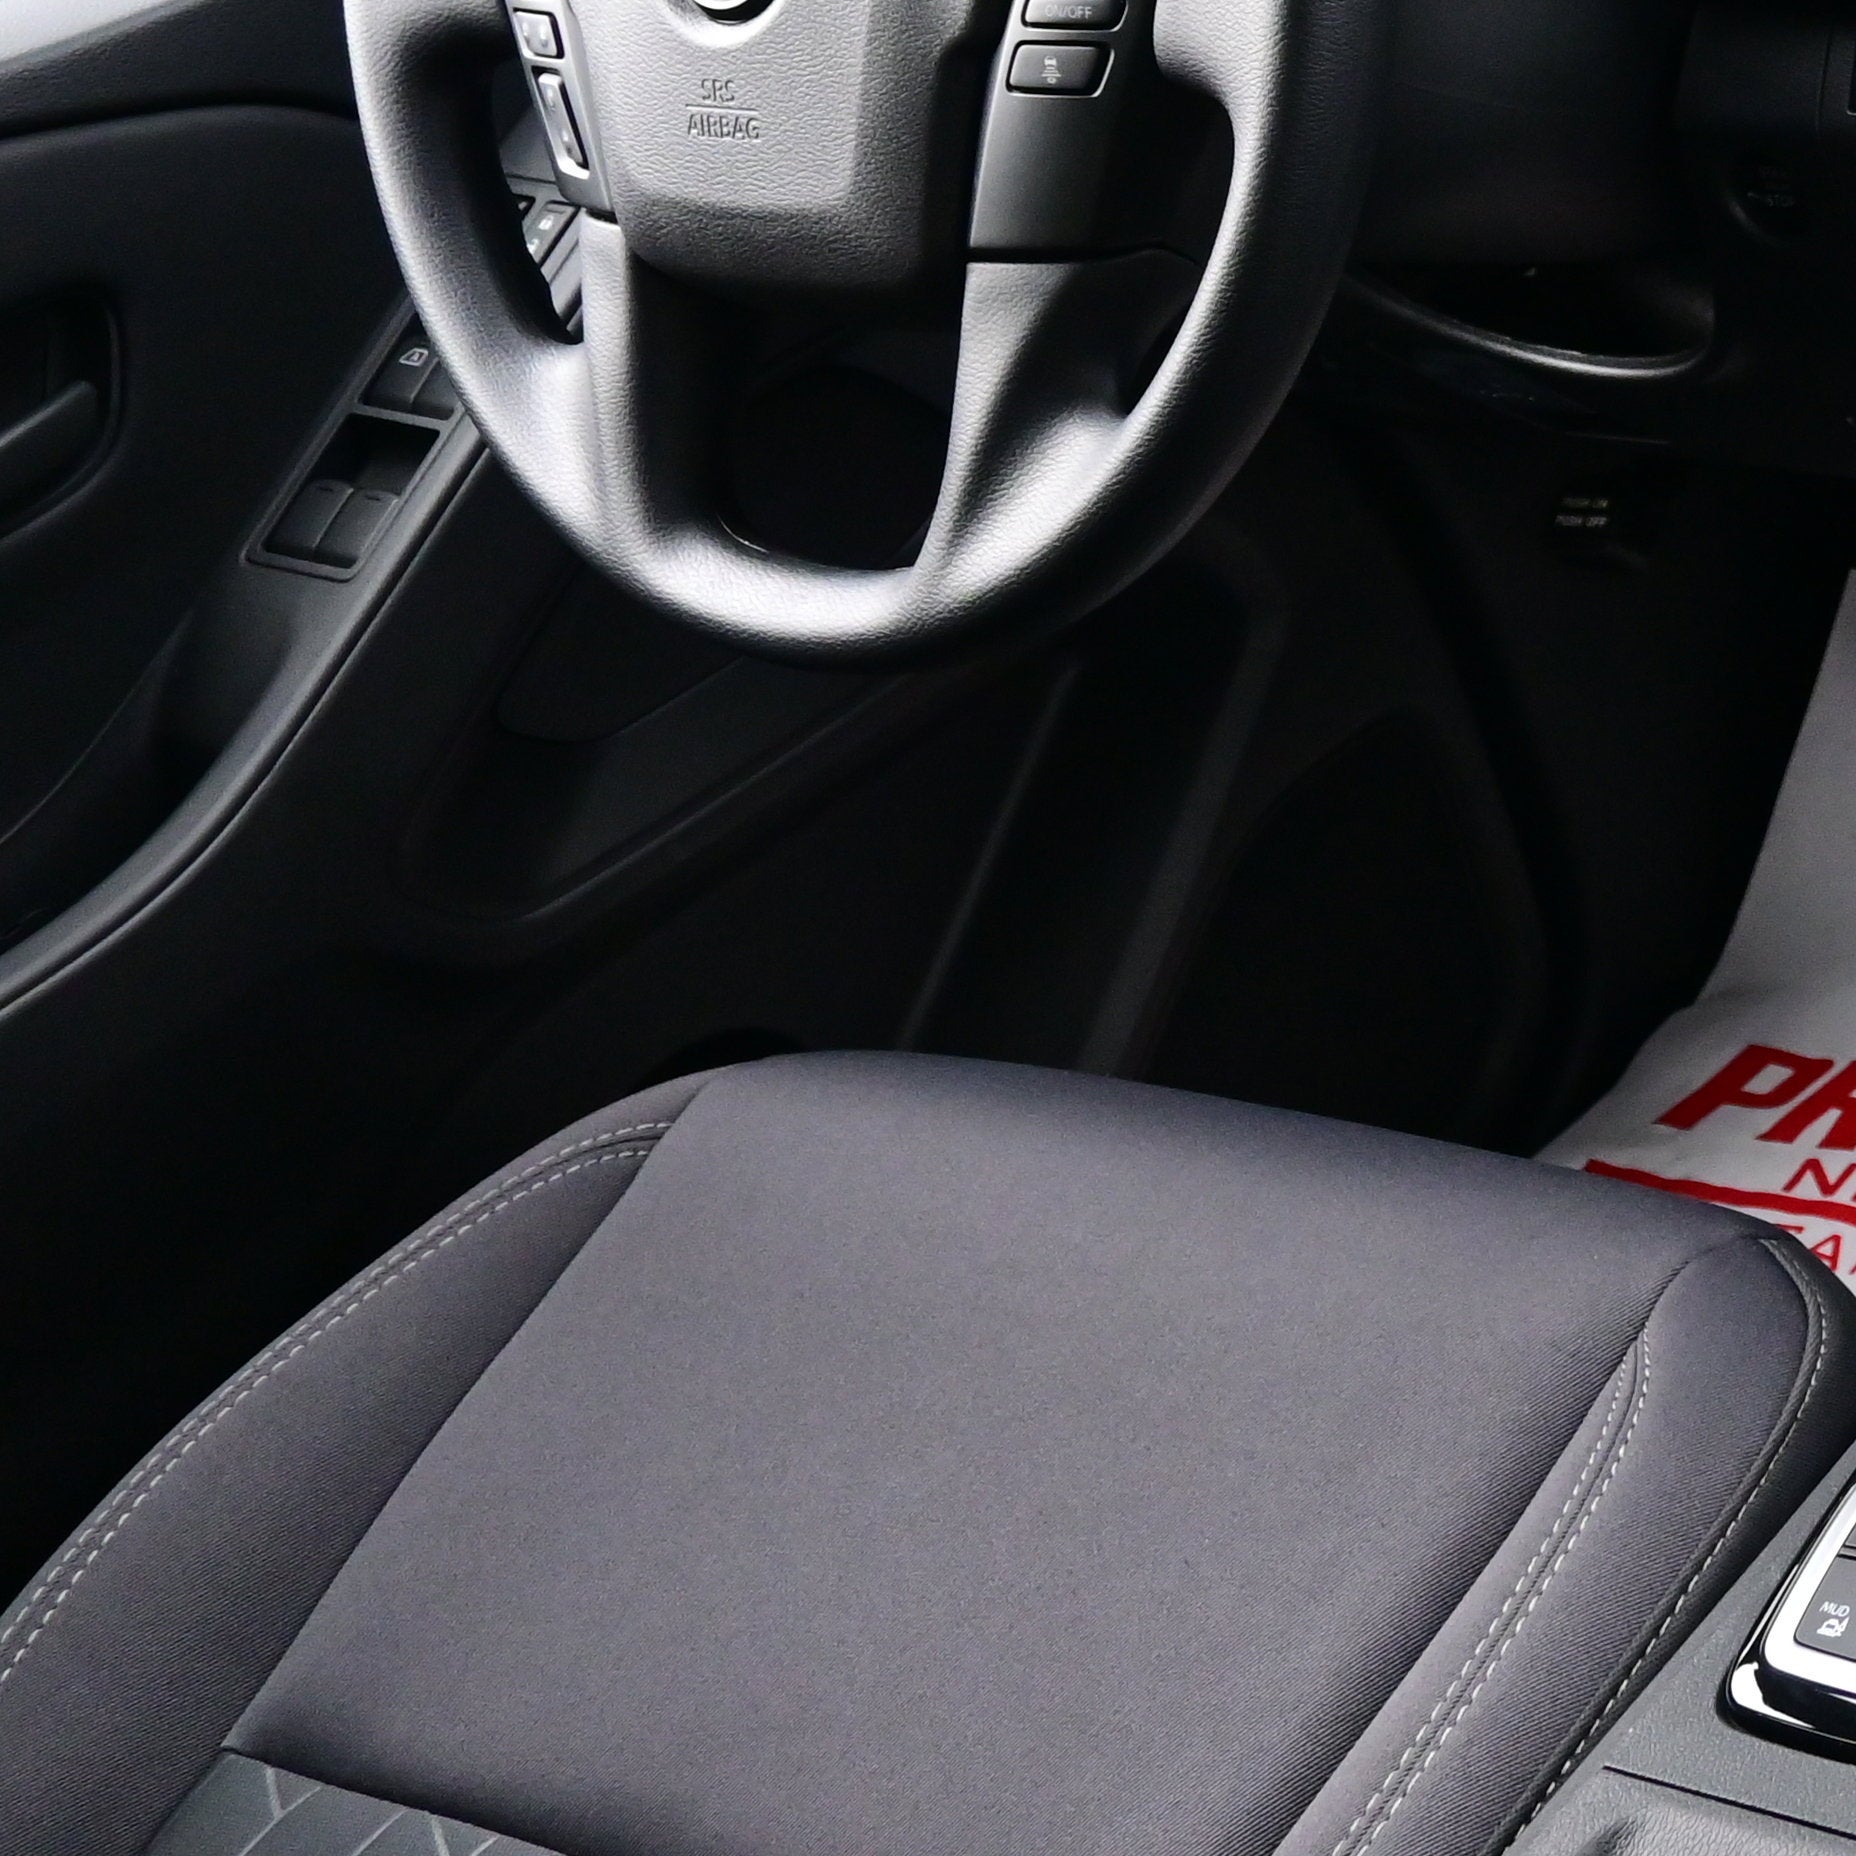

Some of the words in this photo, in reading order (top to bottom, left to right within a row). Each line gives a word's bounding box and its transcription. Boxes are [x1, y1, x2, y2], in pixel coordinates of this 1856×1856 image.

[1044, 6, 1092, 19] ON/OFF
[700, 79, 735, 102] SRS
[687, 114, 760, 139] AIRBAG
[1819, 1601, 1849, 1616] MUD
